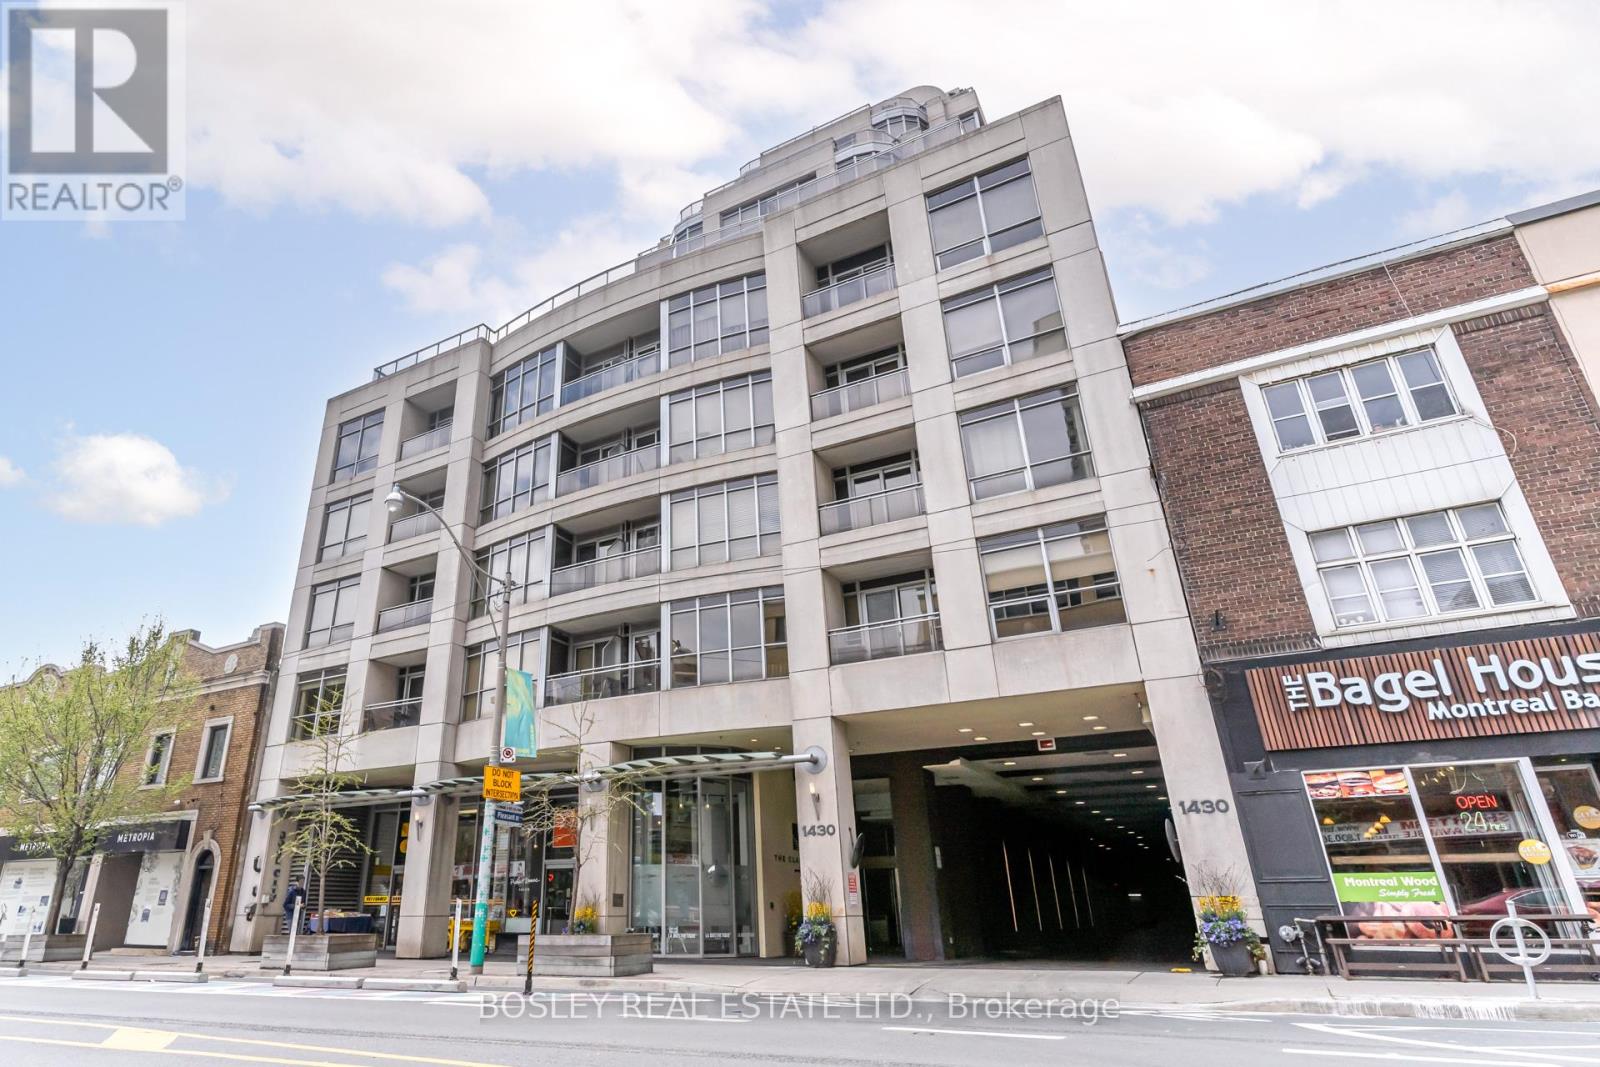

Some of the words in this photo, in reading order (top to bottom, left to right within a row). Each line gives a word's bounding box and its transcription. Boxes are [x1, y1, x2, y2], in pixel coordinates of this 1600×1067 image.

[1306, 658, 1452, 713] Bagel
[1281, 674, 1309, 712] THE
[1428, 690, 1558, 721] Montreal
[492, 768, 501, 777] DO
[502, 770, 514, 779] NOT
[493, 778, 512, 789] BLOCK
[485, 788, 518, 800] INTERSECTION
[1178, 799, 1230, 815] 1430
[1455, 794, 1499, 809] OPEN
[1459, 811, 1488, 832] 24
[116, 831, 155, 843] METROPIA
[801, 824, 836, 837] 1430
[1343, 875, 1398, 888] Montreal
[1400, 875, 1438, 887] Wood
[1378, 888, 1410, 898] Simply
[1411, 887, 1436, 897] Fresh
